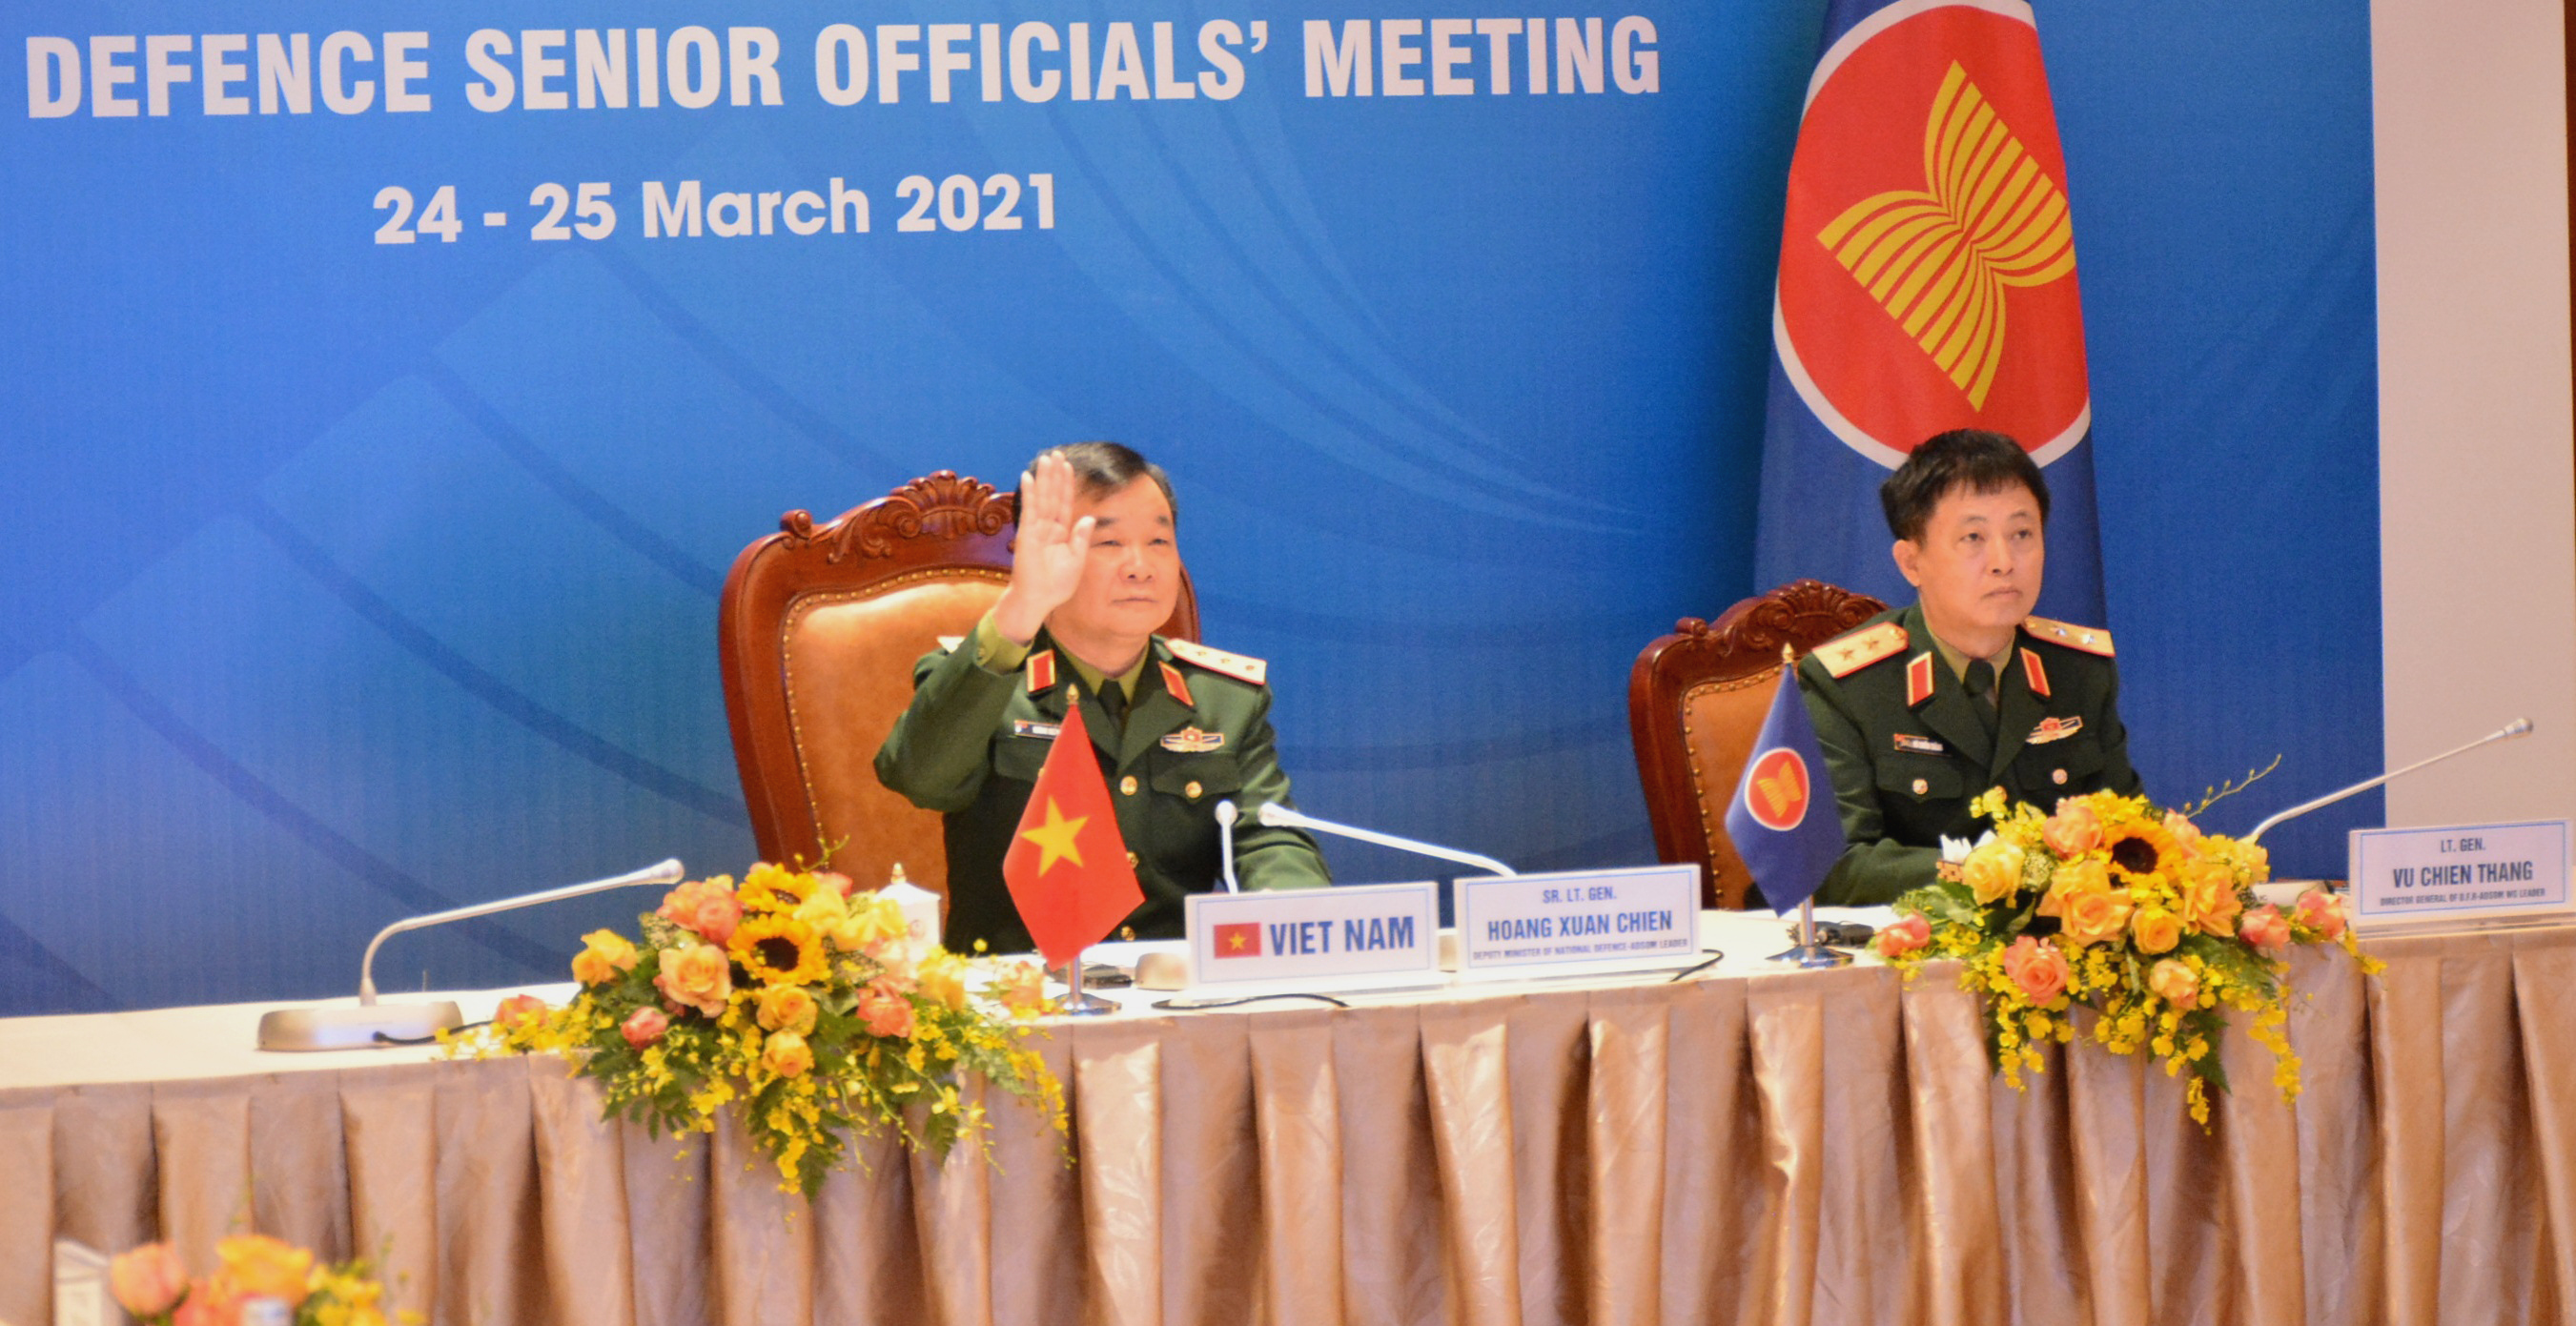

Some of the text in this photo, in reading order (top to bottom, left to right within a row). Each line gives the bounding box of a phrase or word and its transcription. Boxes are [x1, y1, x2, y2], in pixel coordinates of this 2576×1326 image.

[26, 15, 1661, 119] DEFENCE SENIOR OFFICIALS’ MEETING
[373, 173, 1054, 244] 24 - 25 March 2021
[2441, 838, 2486, 853] LT. GEN.
[2393, 861, 2534, 888] VU CHIEN THANG
[1542, 887, 1618, 904] SR. LT. GEN.
[2380, 896, 2414, 906] DIRECTOR
[2416, 894, 2447, 905] GENERAL
[2449, 893, 2458, 902] OF
[2519, 887, 2545, 898] LEADER
[1270, 916, 1415, 956] VIET NAM
[1488, 910, 1673, 941] HOANG XUAN CHIEN
[1473, 951, 1502, 960] DEPUTY
[1504, 949, 1541, 959] MINISTER
[1544, 948, 1552, 956] OF
[1555, 945, 1591, 955] NATIONAL
[1659, 938, 1688, 949] LEADER
